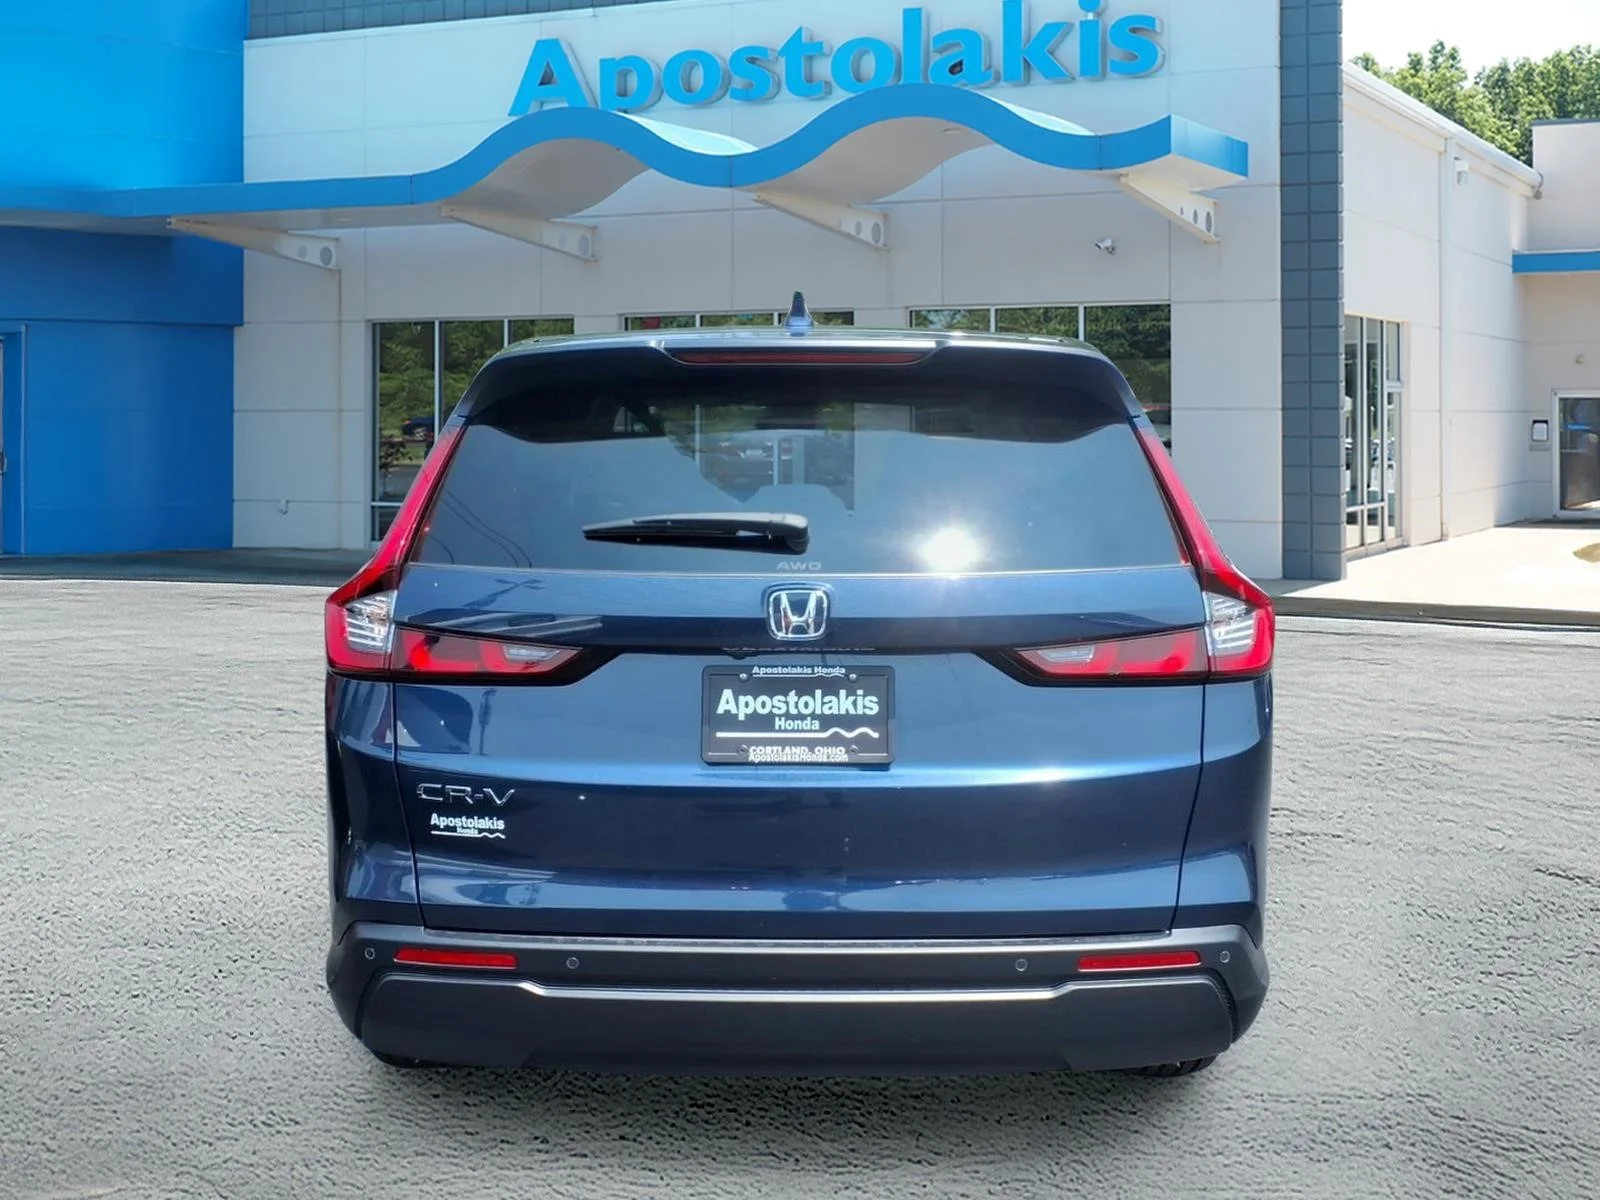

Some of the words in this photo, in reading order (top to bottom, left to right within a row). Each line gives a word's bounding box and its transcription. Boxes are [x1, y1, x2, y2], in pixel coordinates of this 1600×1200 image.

[508, 0, 1165, 117] Apostolakis
[776, 561, 822, 571] AWD
[752, 666, 813, 675] Apostolakis
[814, 666, 846, 675] Honda
[716, 689, 879, 720] Apostolakis
[774, 717, 820, 731] Honda
[814, 747, 846, 756] OHIO
[416, 783, 515, 805] CR-V
[430, 813, 505, 830] Apostolakis
